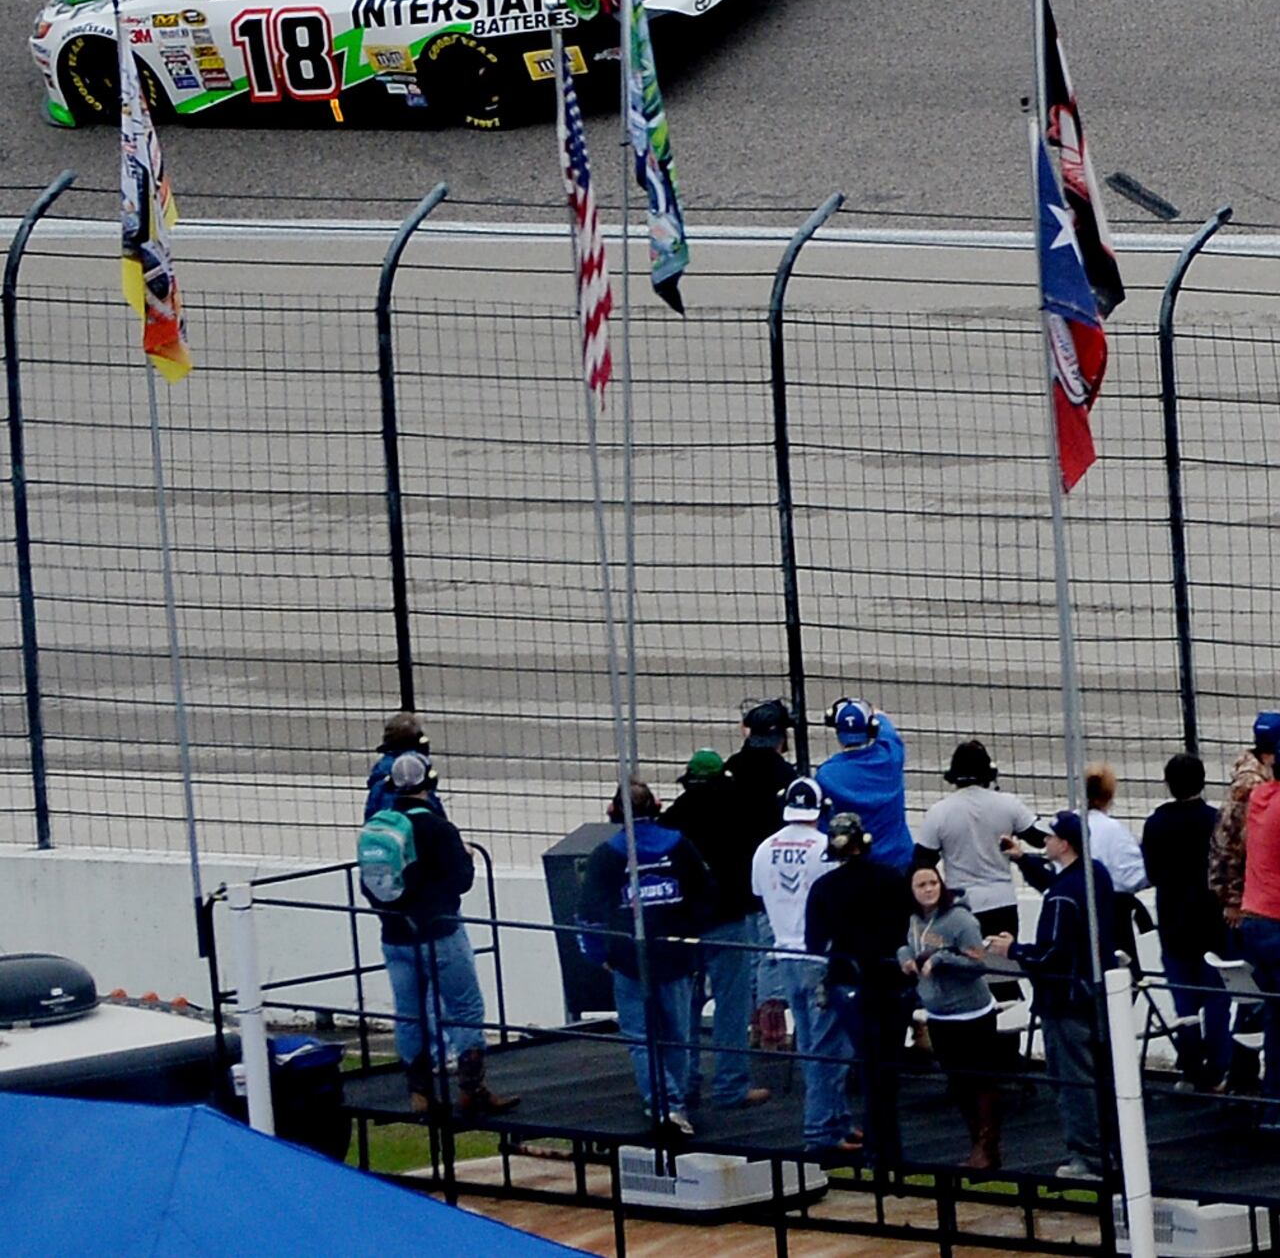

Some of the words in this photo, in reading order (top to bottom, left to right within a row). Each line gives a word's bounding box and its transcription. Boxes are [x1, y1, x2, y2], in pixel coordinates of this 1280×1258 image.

[473, 10, 577, 36] BATTERES
[130, 29, 153, 44] 3M
[231, 7, 341, 103] 18
[68, 37, 103, 111] GOODYEAR
[771, 849, 807, 865] FOX
[627, 882, 674, 900] LWE'S
